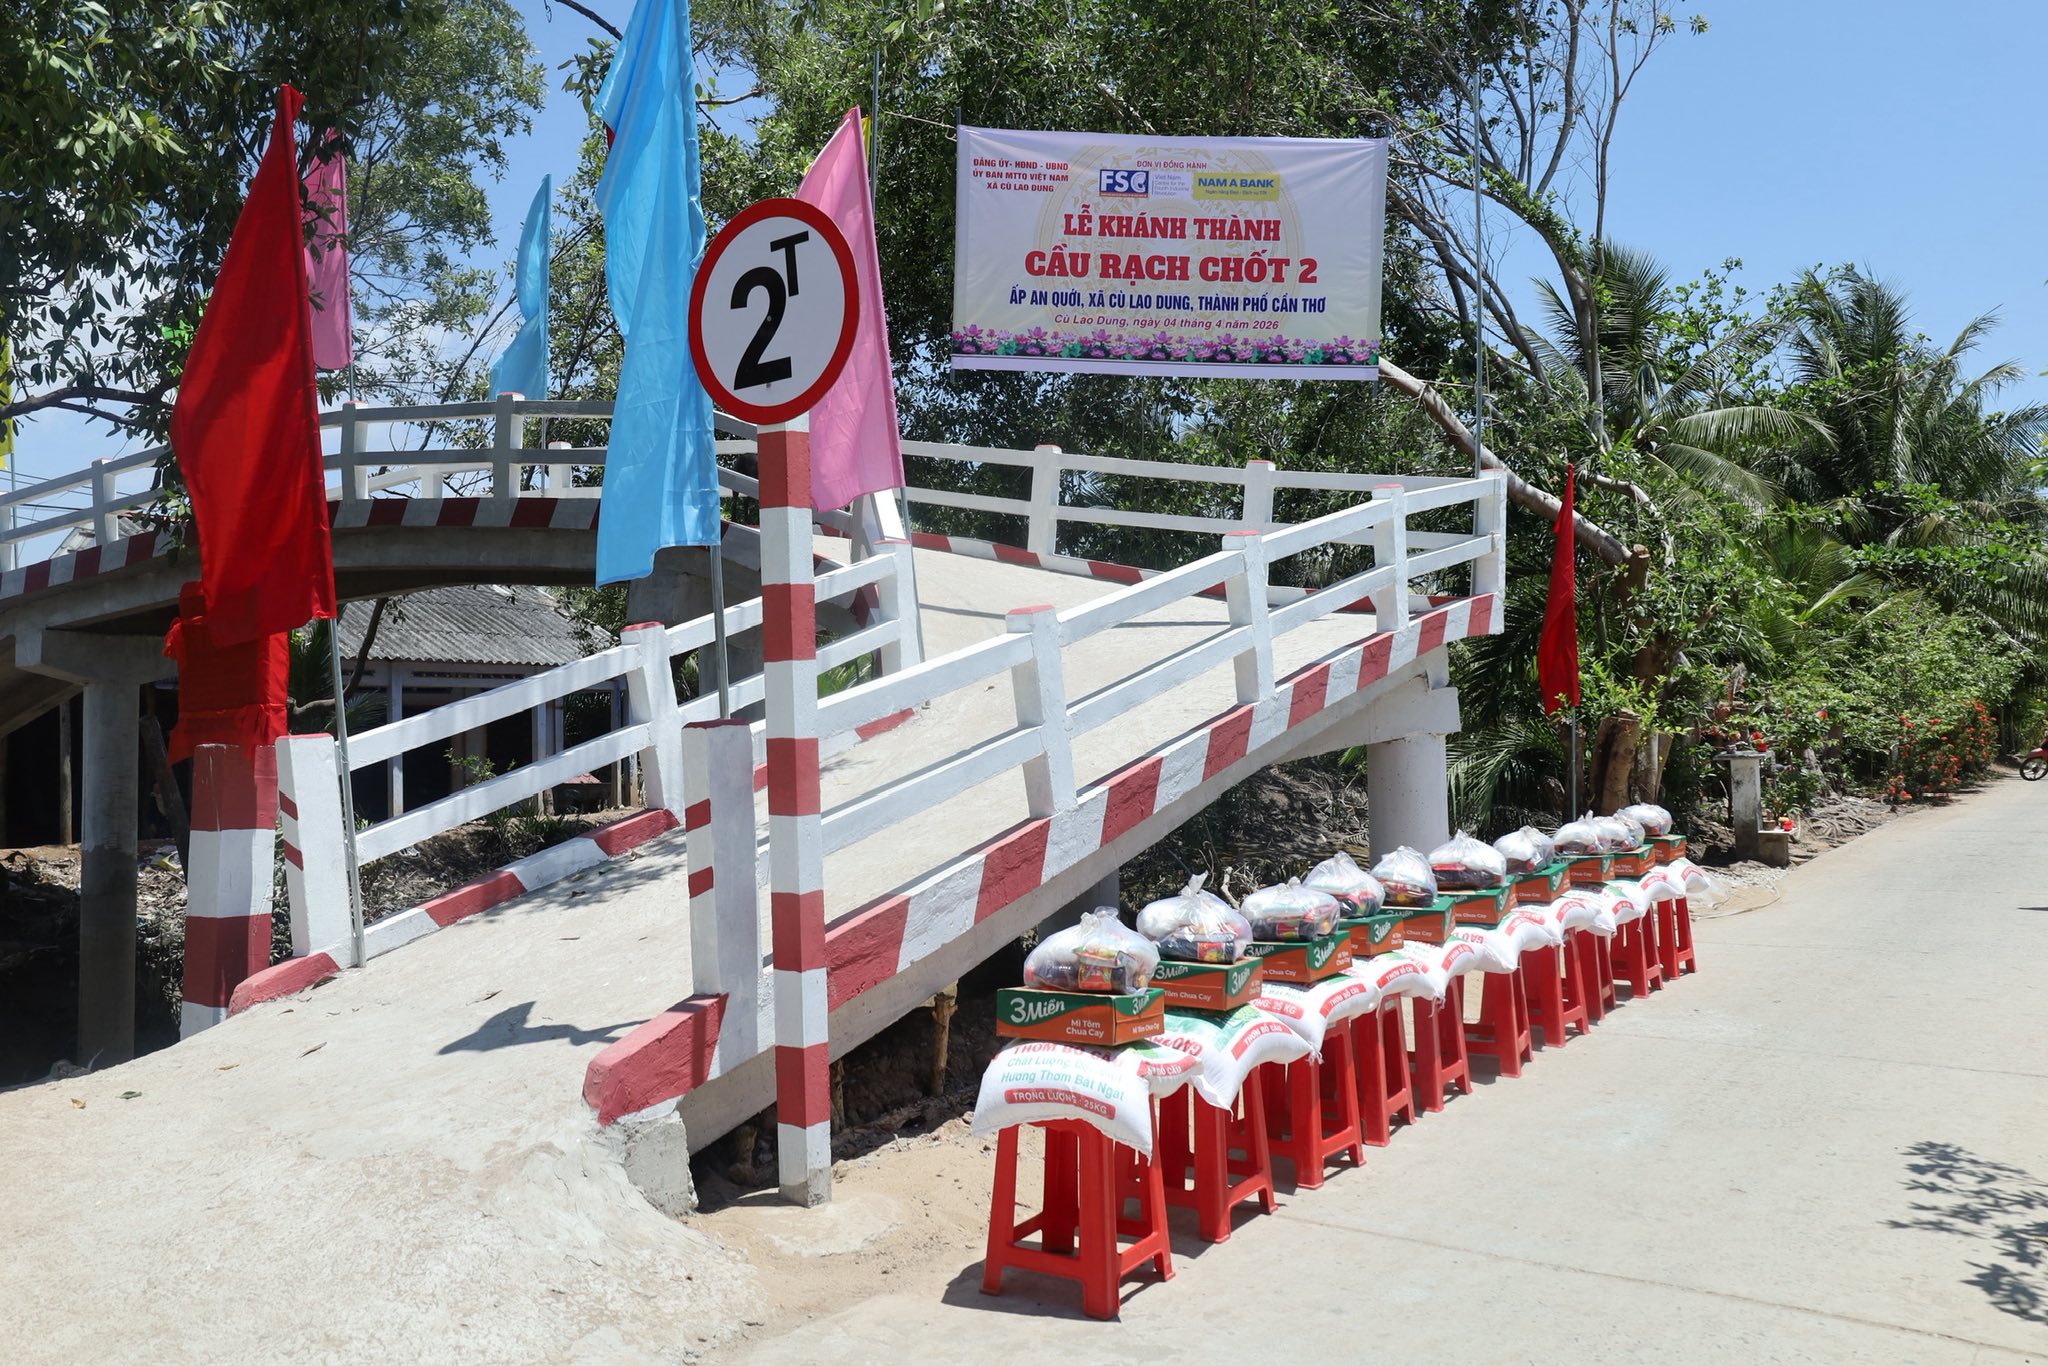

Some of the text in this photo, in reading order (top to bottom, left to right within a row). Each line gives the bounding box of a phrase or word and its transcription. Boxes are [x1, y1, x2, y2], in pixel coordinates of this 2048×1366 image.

[1046, 162, 1068, 170] UBND
[1049, 174, 1069, 182] NAM
[1198, 178, 1274, 188] NAM A BANK
[1014, 183, 1029, 191] LAO
[1031, 184, 1054, 192] DUNG
[1064, 204, 1281, 241] LỄ KHÁNH THÀNH
[1024, 244, 1318, 286] CẦU RẠCH CHỐT 2
[1010, 284, 1027, 305] ẤP
[1030, 290, 1047, 305] AN
[1088, 290, 1105, 308] XÃ
[1109, 290, 1125, 309] CÙ
[1129, 294, 1150, 309] LAO
[1156, 295, 1194, 312] DUNG,
[1198, 293, 1239, 311] THÀNH
[1243, 292, 1268, 312] PHỐ
[1272, 293, 1298, 312] CẦN
[1302, 297, 1326, 313] THƠ
[1054, 314, 1279, 330] Cù Lao Dung, ngày 04 tháng 4 năm 2026
[1066, 1027, 1104, 1039] Chua Cay
[1084, 1100, 1108, 1114] 25KG
